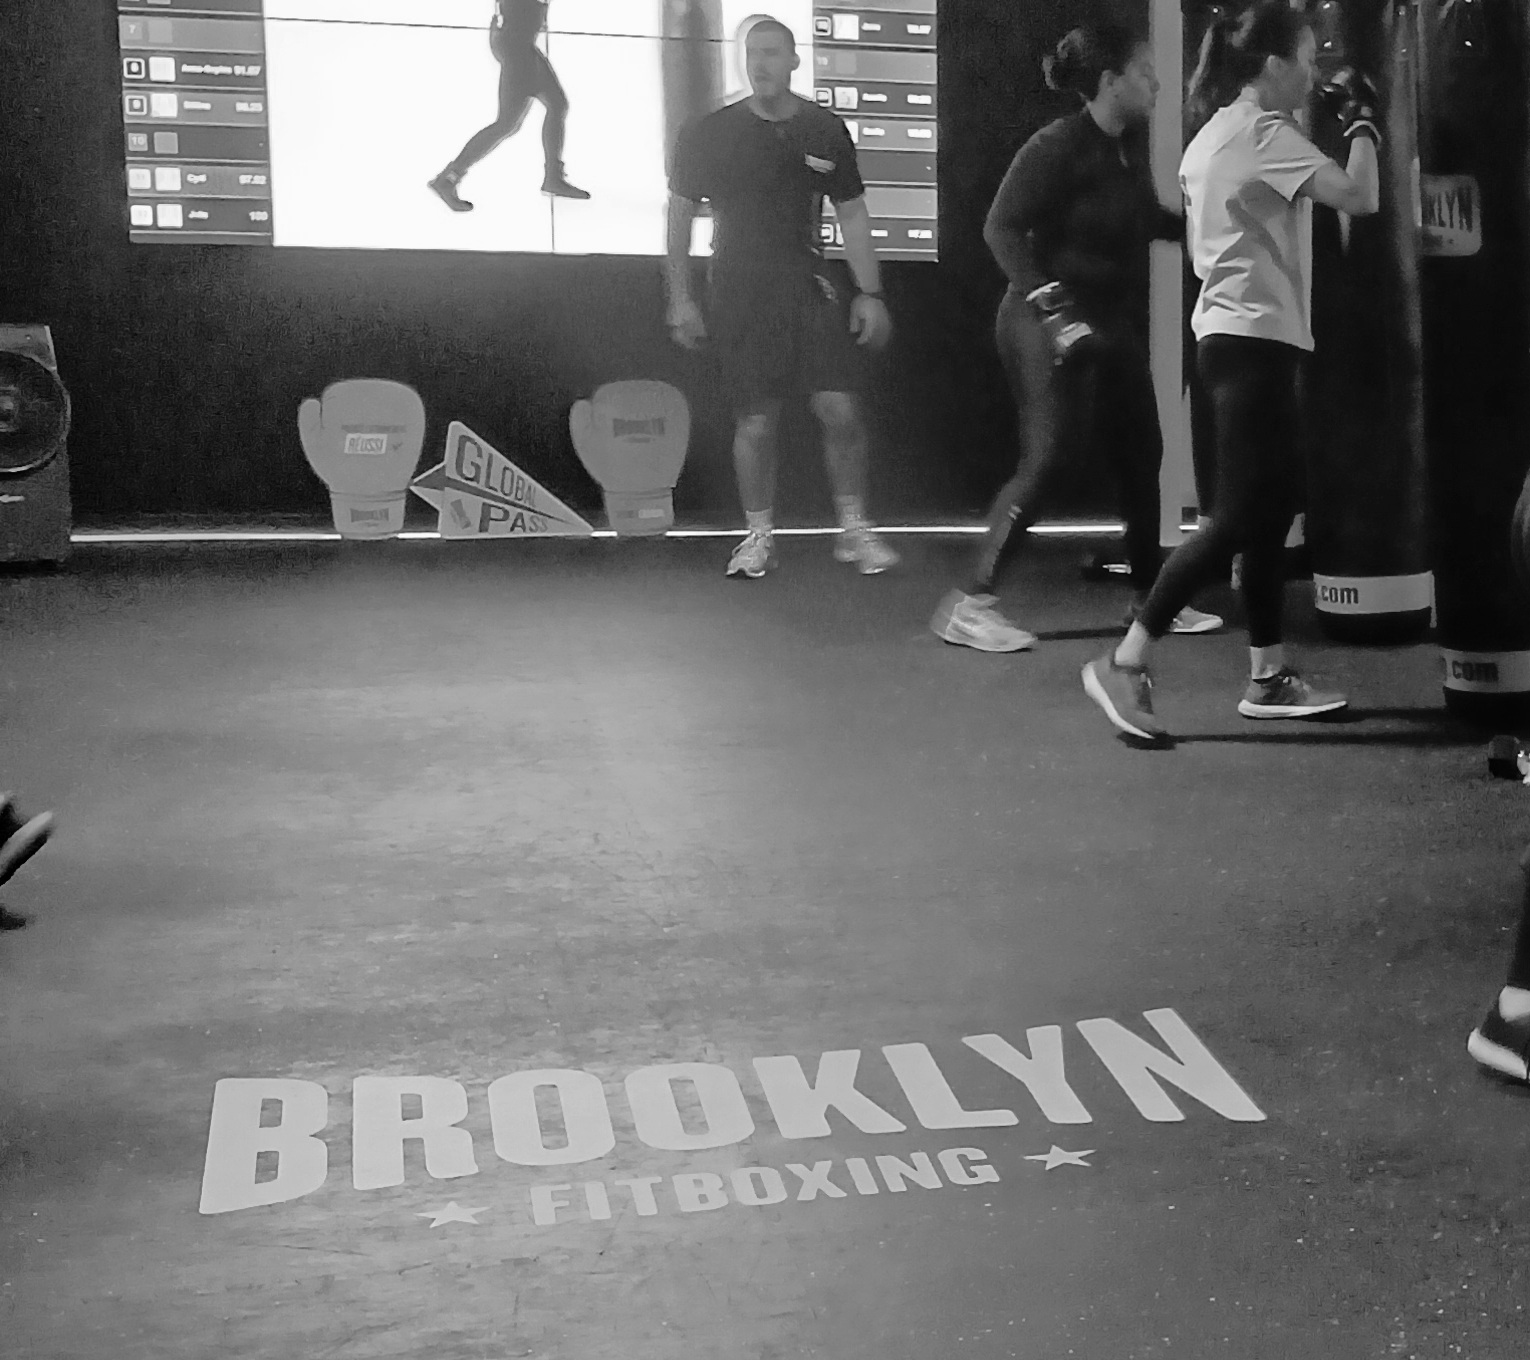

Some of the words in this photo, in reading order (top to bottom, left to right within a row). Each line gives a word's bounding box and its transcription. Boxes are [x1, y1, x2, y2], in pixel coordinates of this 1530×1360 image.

[1420, 188, 1473, 234] KLYN
[478, 501, 549, 534] PASS
[198, 1006, 1268, 1215] BROOKLYN
[529, 1146, 1001, 1227] FITBOXING
